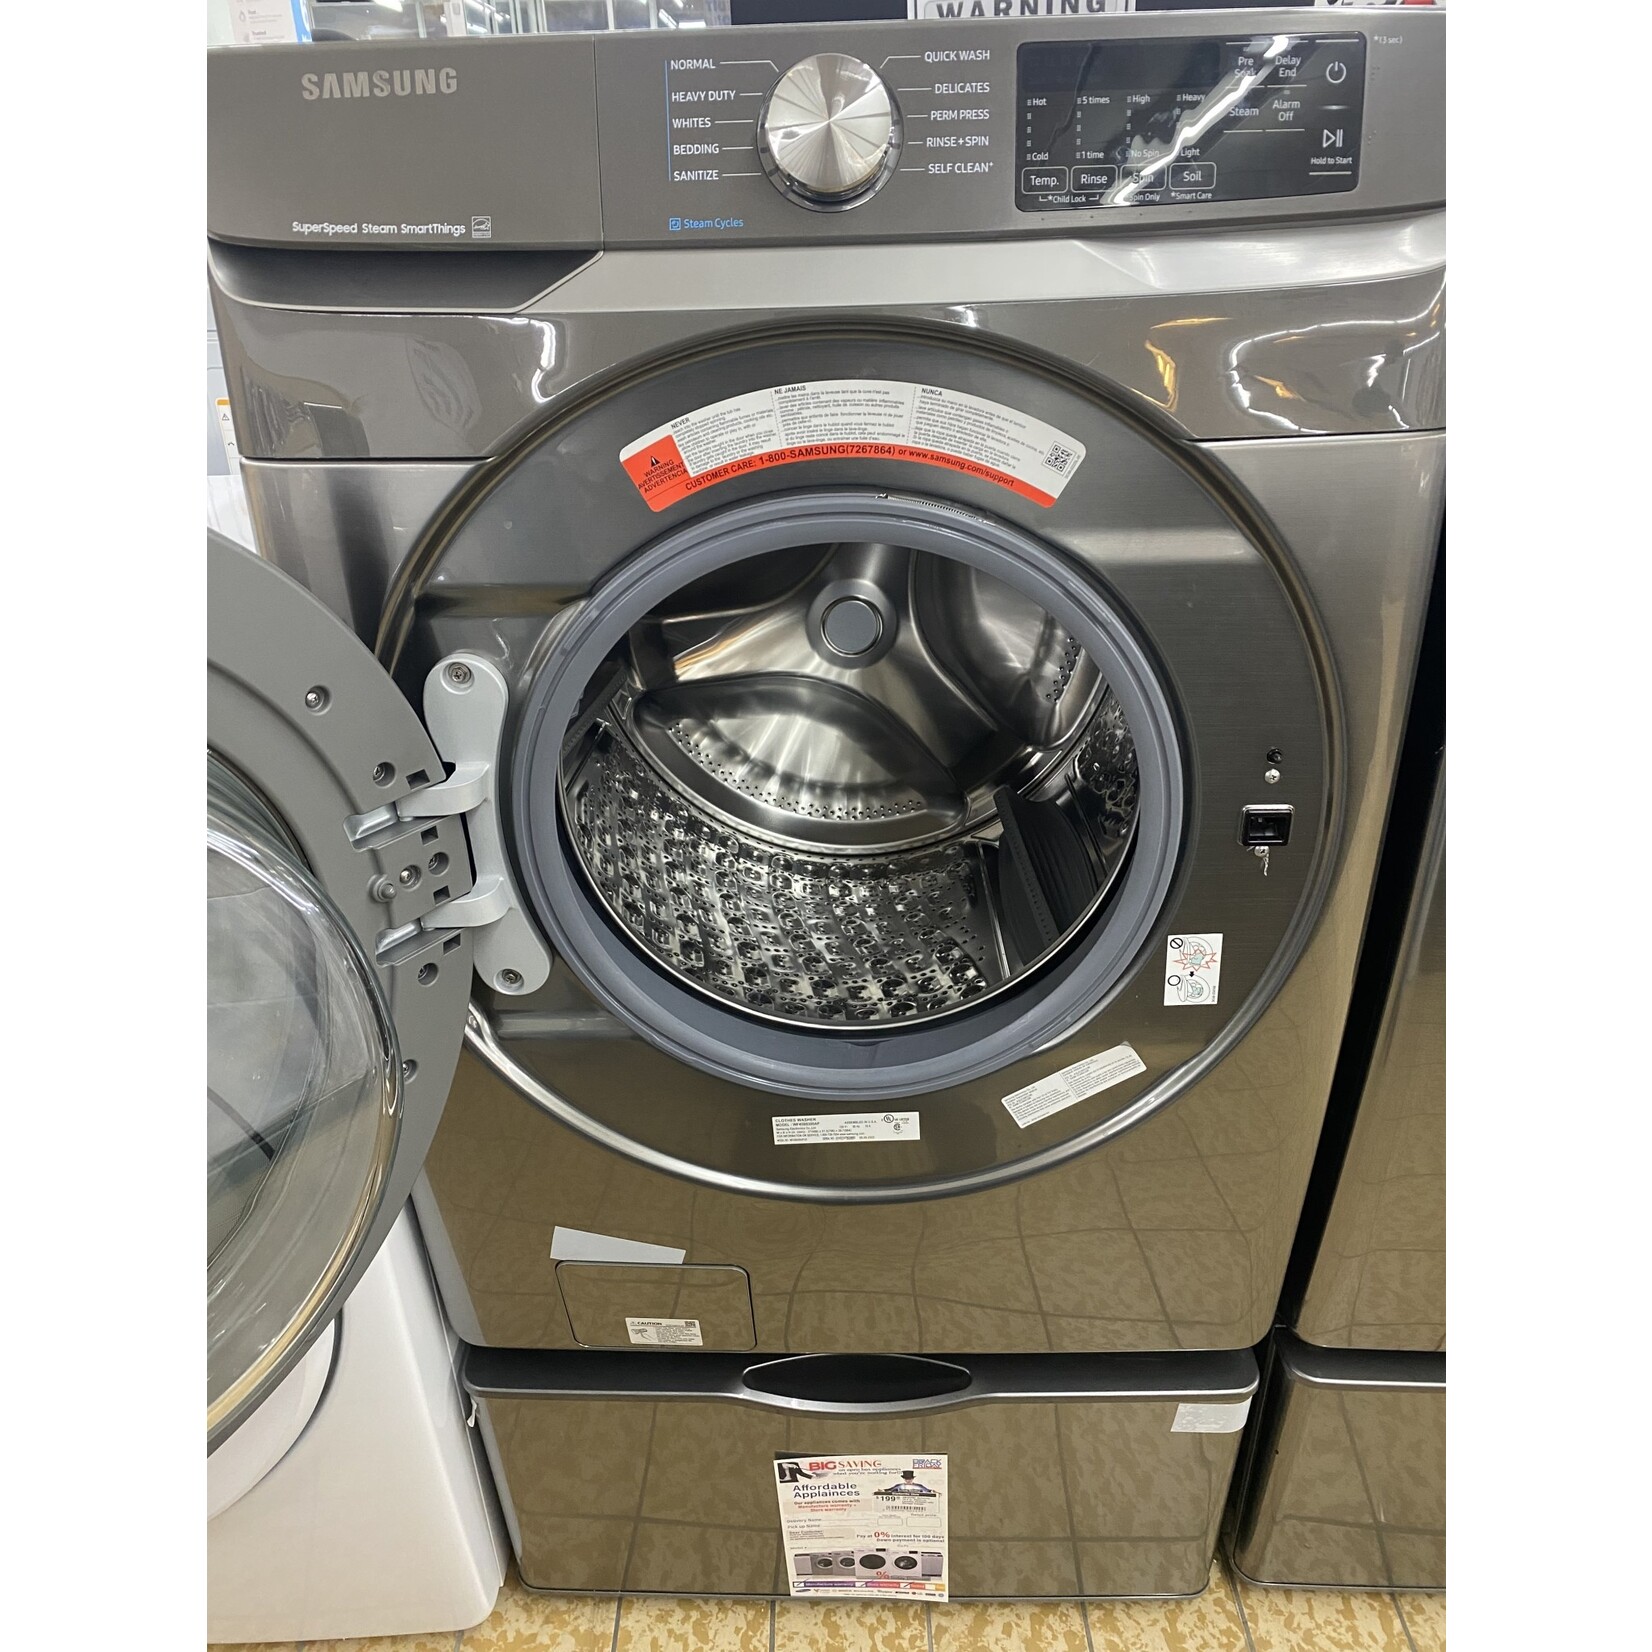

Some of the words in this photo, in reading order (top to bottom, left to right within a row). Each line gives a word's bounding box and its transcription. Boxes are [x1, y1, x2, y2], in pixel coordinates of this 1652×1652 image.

[936, 0, 1106, 18] WARNING
[924, 50, 957, 63] QUICK
[959, 49, 990, 61] WASH
[1238, 56, 1254, 66] Pre
[1275, 55, 1302, 67] Delay
[670, 59, 716, 70] NORMAL
[1234, 68, 1257, 78] Soak
[1279, 67, 1297, 77] End
[301, 67, 457, 100] SAMSUNG
[934, 82, 990, 94] DELICATES
[671, 91, 706, 102] HEAVY
[708, 90, 736, 101] DUTY
[1082, 96, 1088, 104] 5
[1088, 95, 1110, 105] times
[1132, 94, 1151, 104] High
[1182, 93, 1206, 103] Heavy
[1032, 98, 1047, 106] Hot
[1272, 99, 1301, 109] Alarm
[930, 110, 958, 121] PERM
[959, 109, 990, 120] PRESS
[1229, 106, 1259, 116] Steam
[1278, 110, 1294, 121] Off
[672, 117, 711, 128] WHITES
[673, 143, 720, 155] BEDDING
[1131, 149, 1141, 158] No
[1143, 148, 1160, 158] Spin
[1180, 148, 1200, 158] Light
[1032, 152, 1049, 161] Cold
[1081, 151, 1086, 159] 1
[1086, 150, 1105, 160] time
[1310, 156, 1327, 165] Hold
[1327, 157, 1335, 165] to
[1335, 156, 1353, 165] Start
[928, 163, 953, 174] SELF
[673, 170, 719, 181] SANITIZE
[1030, 175, 1060, 187] Temp.
[1080, 173, 1108, 184] Rinse
[1132, 171, 1154, 184] Spin
[1183, 170, 1202, 181] Soil
[1072, 194, 1087, 203] Lock
[1144, 193, 1160, 203] Only
[1197, 191, 1212, 199] Care
[292, 221, 357, 236] SuperSpeed
[362, 223, 398, 234] Steam
[401, 222, 466, 237] SmartThings
[683, 218, 713, 229] Steam
[714, 217, 744, 230] Cycles
[784, 385, 807, 394] JAMAIS
[921, 387, 943, 397] NUNCA
[671, 417, 691, 430] NEVER
[644, 459, 675, 478] WARNING
[685, 464, 730, 491] CUSTOMER
[730, 458, 757, 474] CARE:
[758, 444, 896, 466] 1-800-SAMSUNG(7267864)
[898, 447, 908, 456] or
[909, 449, 1015, 487] www.samsung.com/support
[638, 461, 684, 489] AVERTISSEMENT
[644, 470, 688, 493] ADVERTENCIA
[809, 1461, 837, 1471] BIG
[838, 1460, 882, 1468] SAVING
[793, 1482, 858, 1492] Affordable
